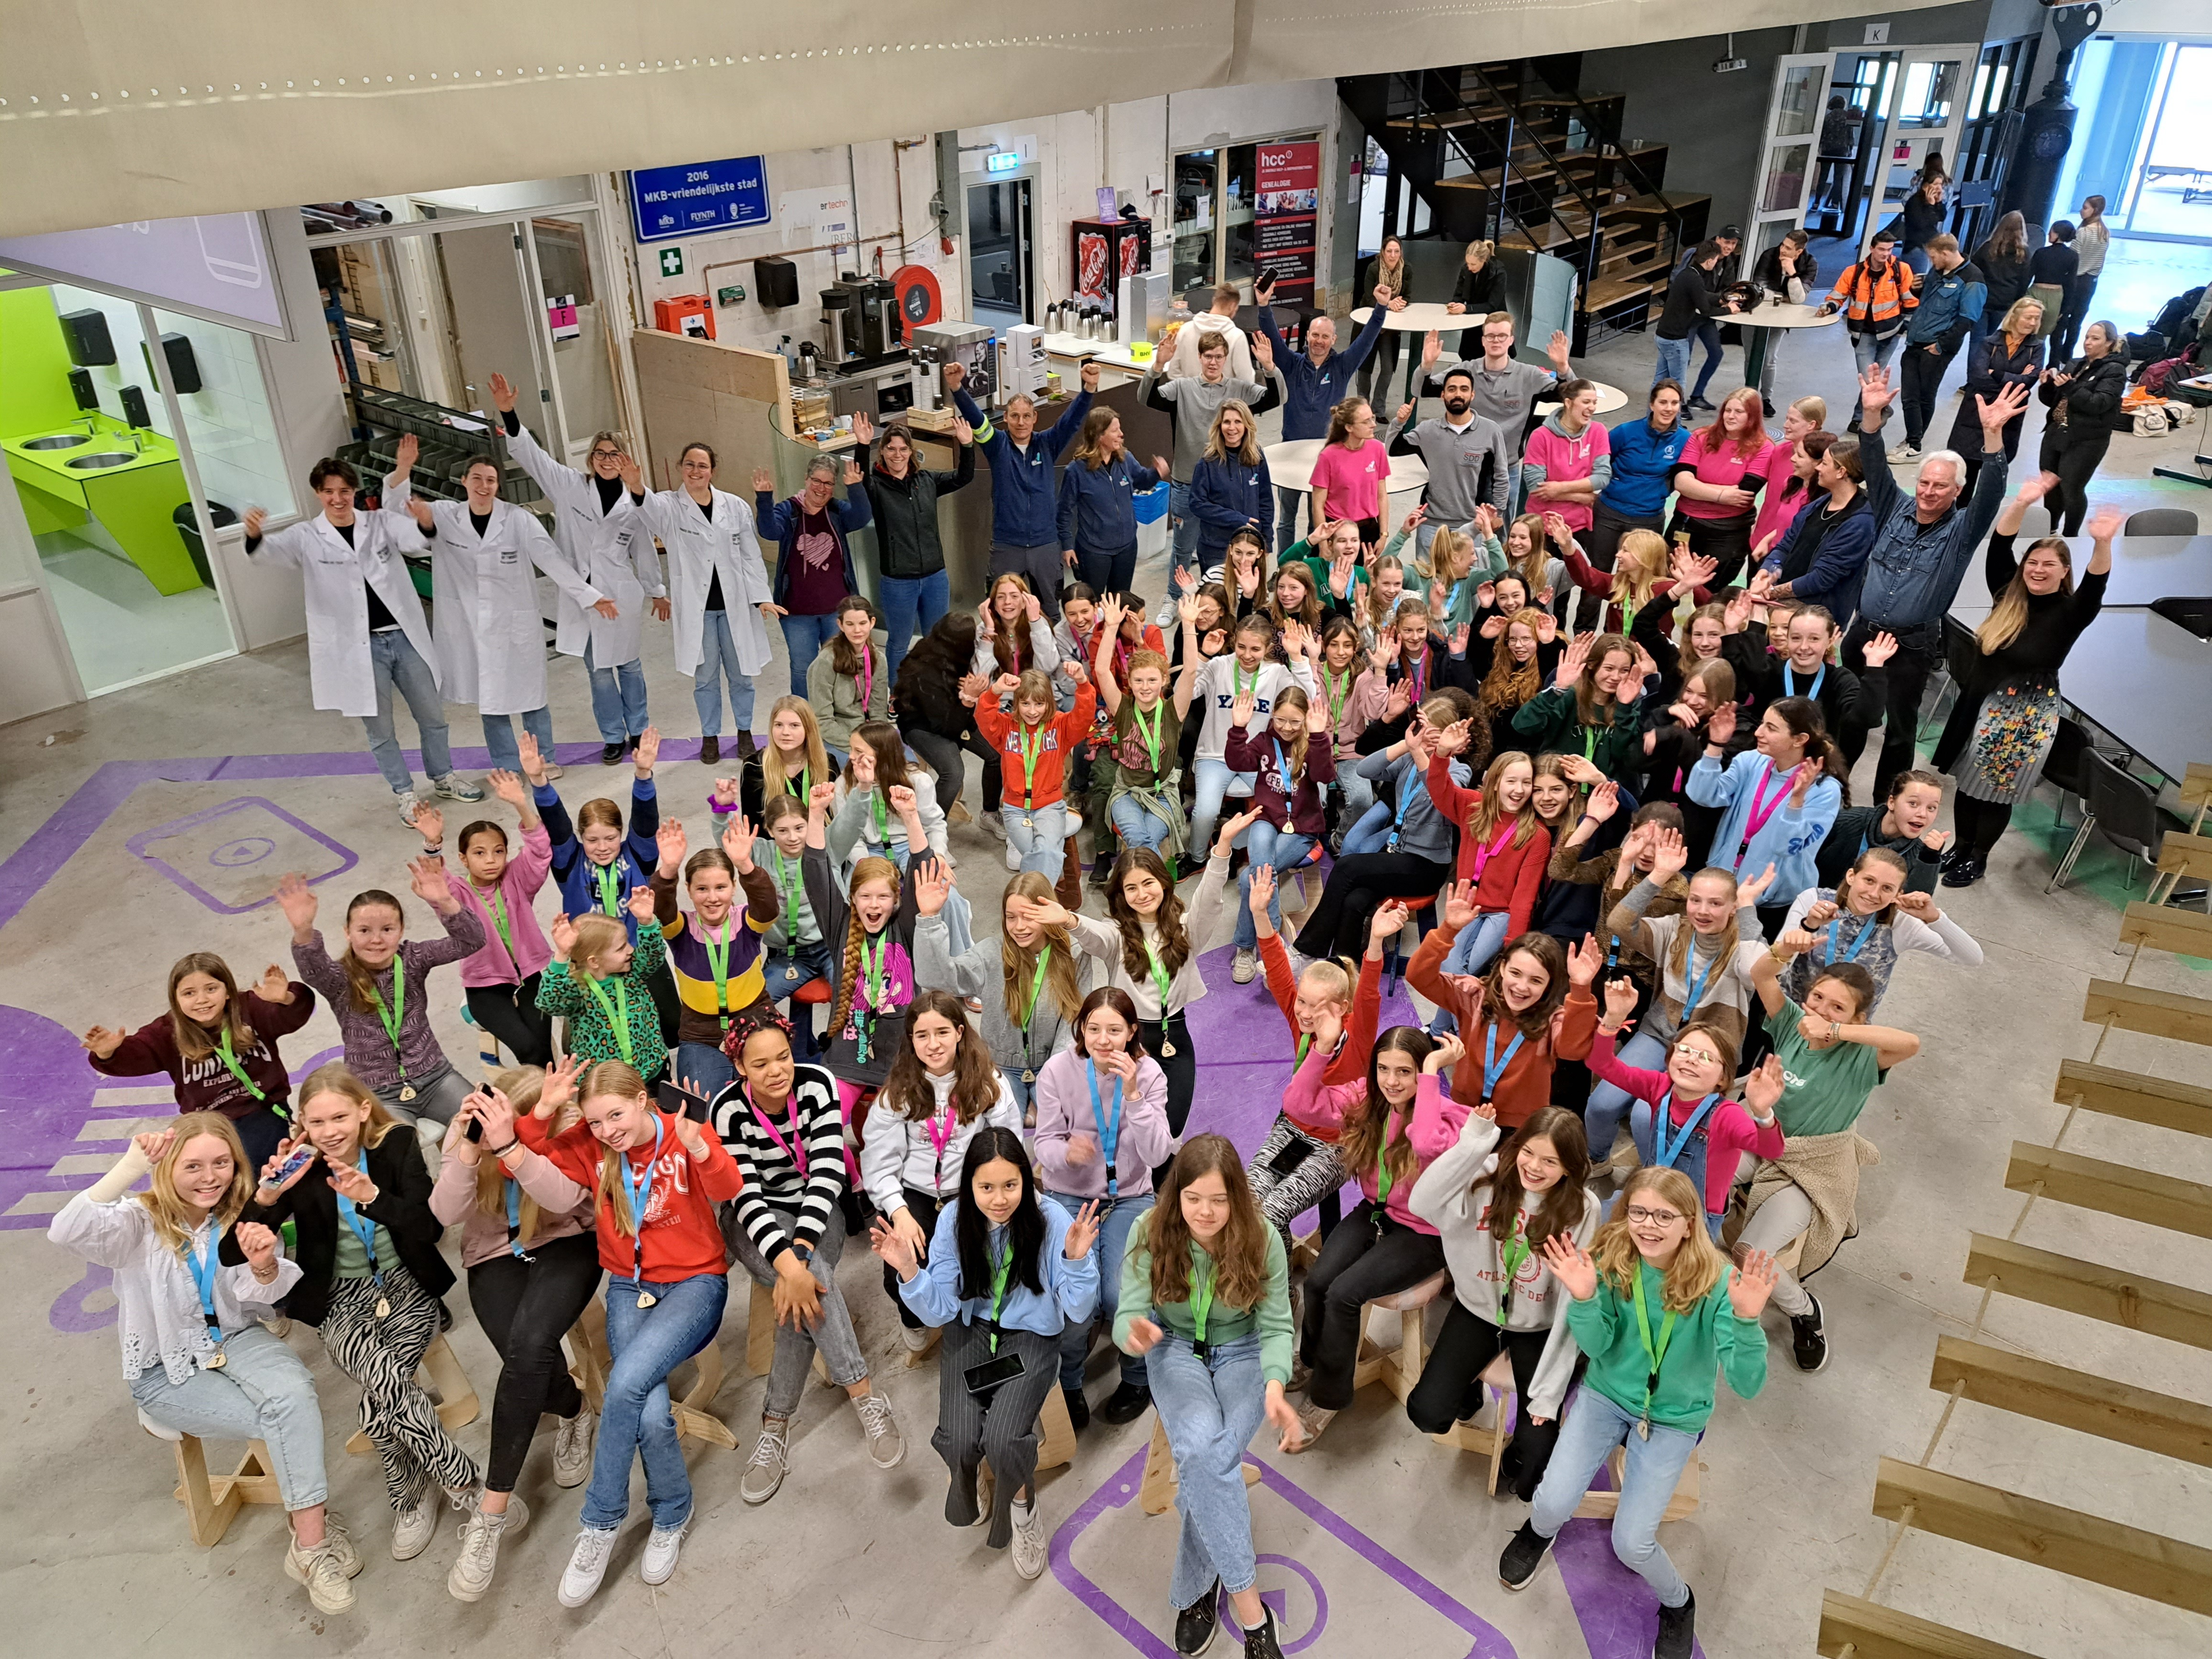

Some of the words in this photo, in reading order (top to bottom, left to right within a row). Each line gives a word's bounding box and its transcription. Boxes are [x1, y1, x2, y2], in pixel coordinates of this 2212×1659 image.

[1873, 29, 1880, 41] K
[1261, 152, 1285, 167] hcc
[686, 170, 709, 182] 2016
[1261, 179, 1291, 188] GENEALOGIE
[644, 182, 735, 203] MKB-vriendelijkste
[737, 177, 757, 189] stad
[658, 215, 675, 226] MKB
[690, 210, 716, 221] FLYNTH
[561, 310, 566, 325] F
[1463, 454, 1480, 462] SDD
[1217, 695, 1270, 714] YE
